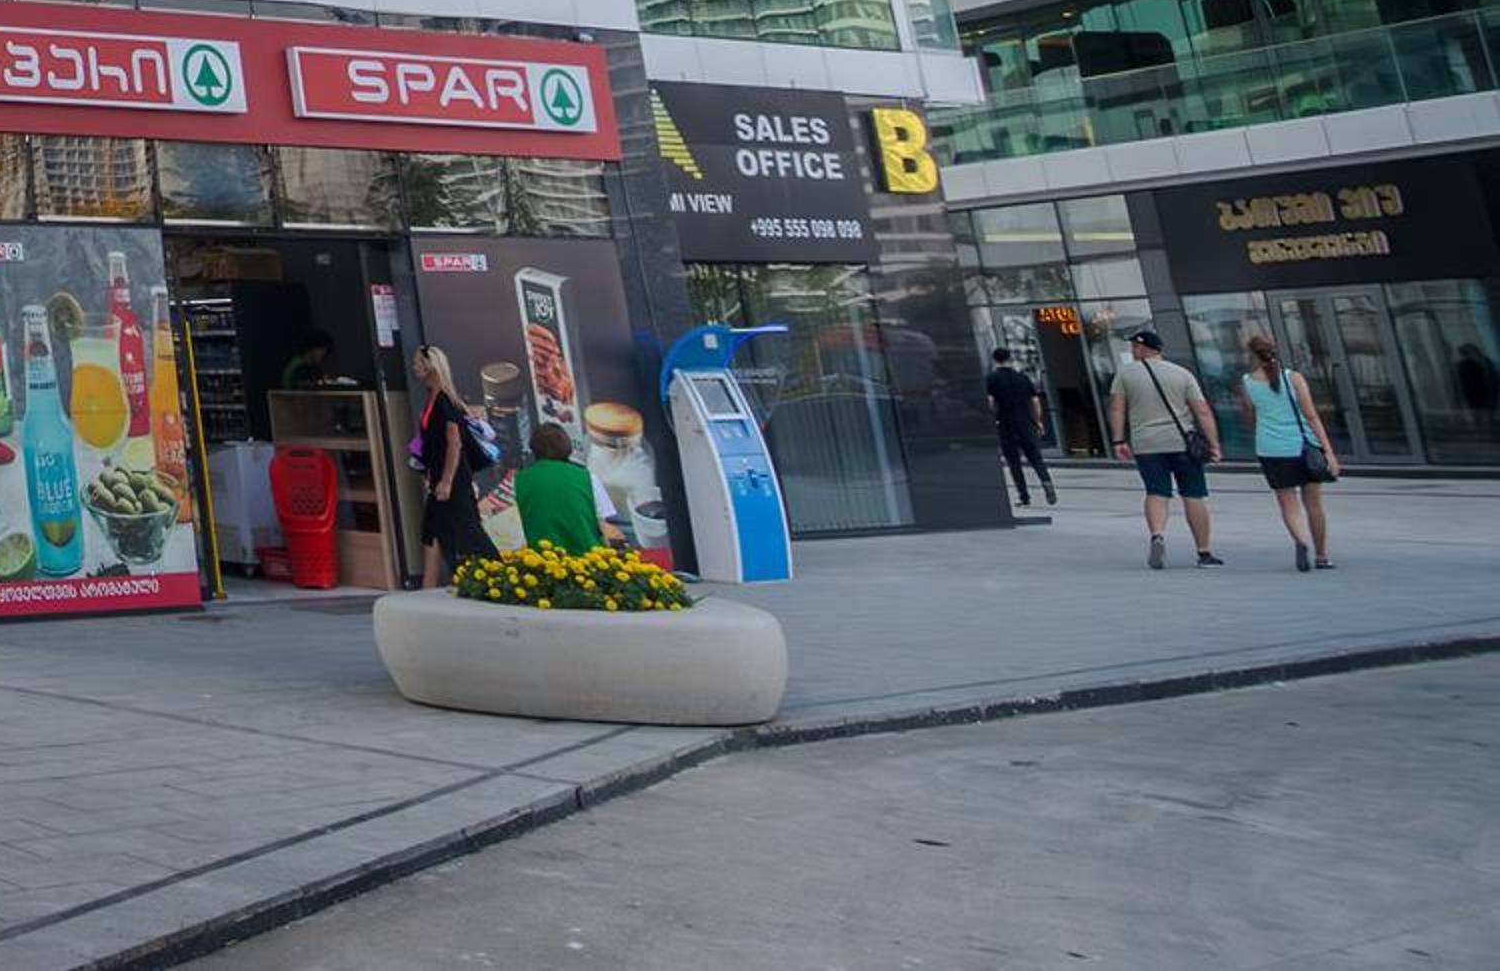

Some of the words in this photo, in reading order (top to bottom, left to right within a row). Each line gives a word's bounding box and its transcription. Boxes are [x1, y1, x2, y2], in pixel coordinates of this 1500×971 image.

[347, 59, 529, 113] SPAR
[733, 113, 831, 144] SALES
[735, 150, 845, 179] OFFICE
[871, 107, 938, 193] B
[687, 194, 732, 213] VIEW
[751, 218, 782, 237] +995
[784, 219, 810, 238] 555
